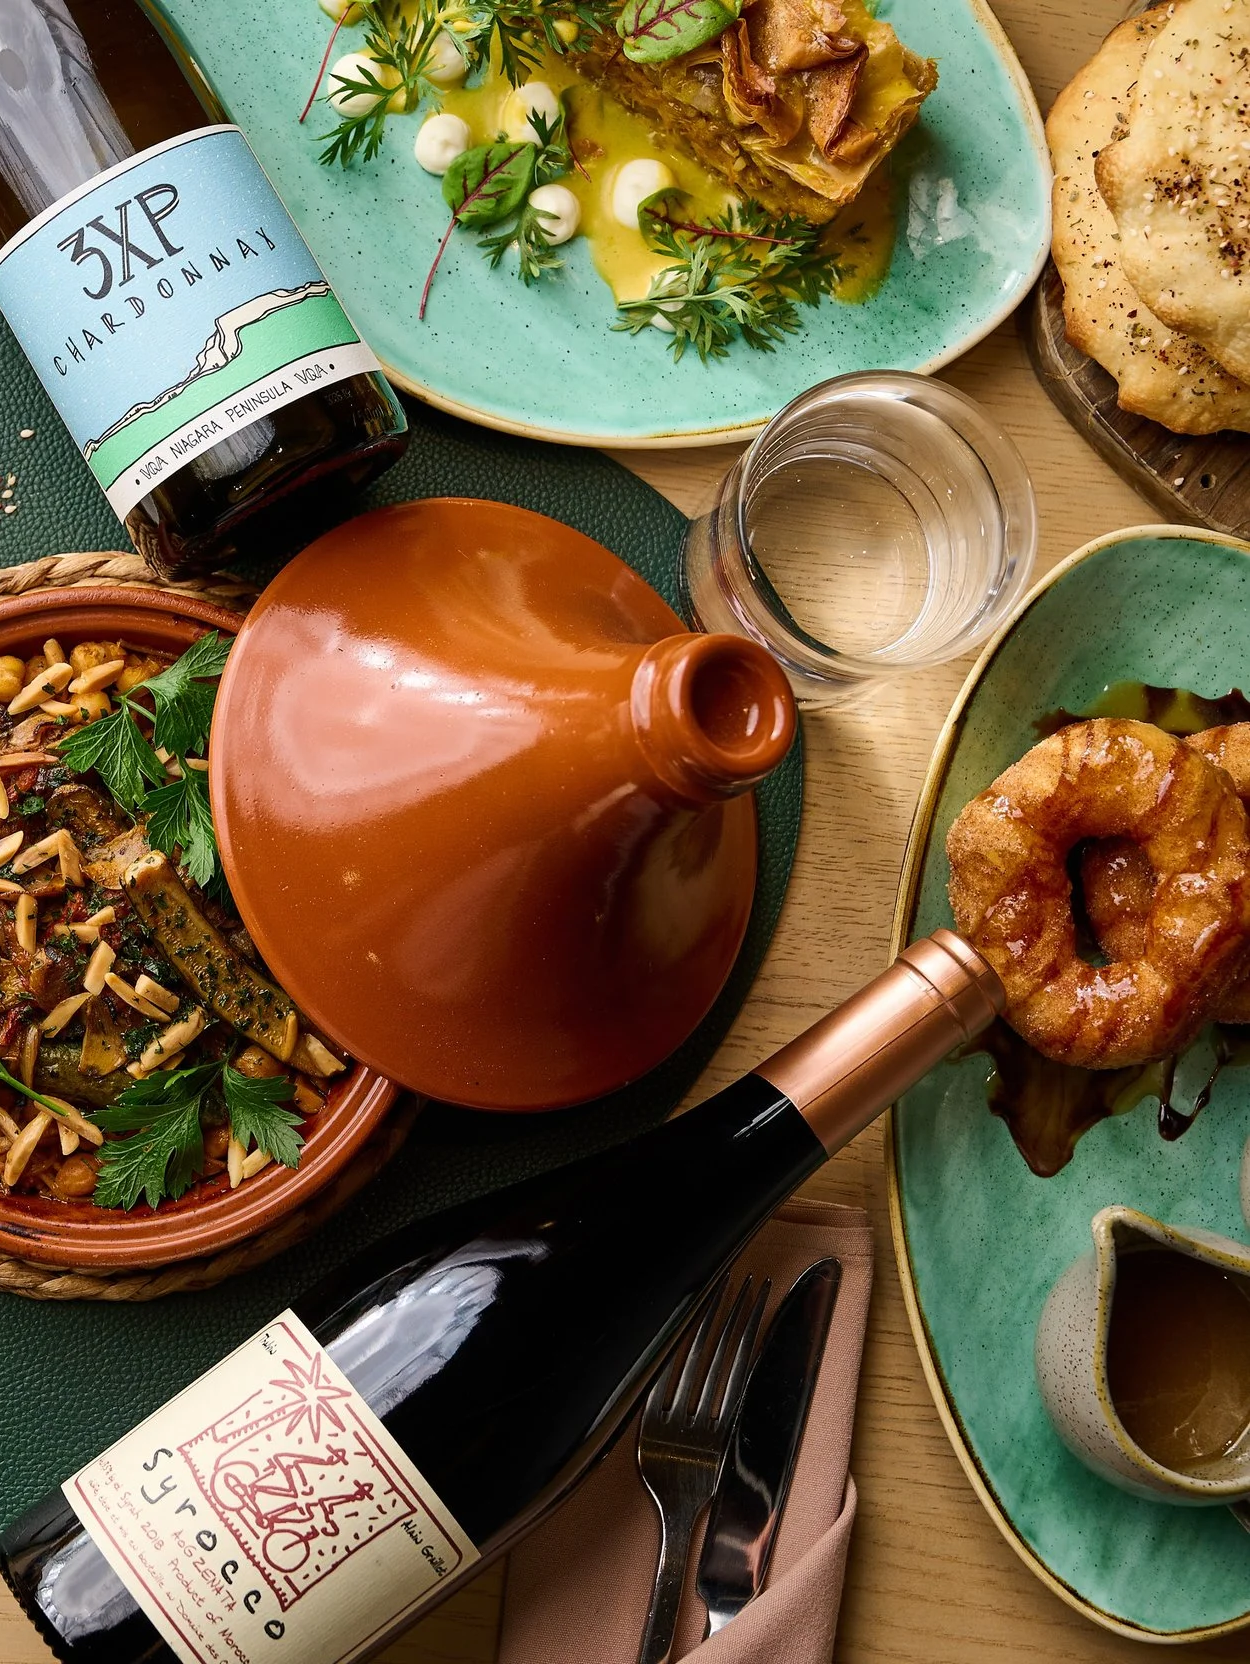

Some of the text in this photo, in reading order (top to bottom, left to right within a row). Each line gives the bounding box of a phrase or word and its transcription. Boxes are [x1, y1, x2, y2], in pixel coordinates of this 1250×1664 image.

[56, 183, 185, 301] 3XP
[52, 226, 277, 377] CHARDONNAY
[139, 455, 170, 481] VQA
[169, 420, 224, 459] NIAGARA
[224, 380, 294, 423] PENINSULA
[293, 363, 329, 385] VQA
[140, 1447, 286, 1640] Syrocco
[140, 1521, 165, 1551] 2018
[167, 1557, 206, 1608] Product
[205, 1611, 224, 1625] of
[192, 1556, 238, 1613] ZENATA
[400, 1519, 424, 1546] Alain
